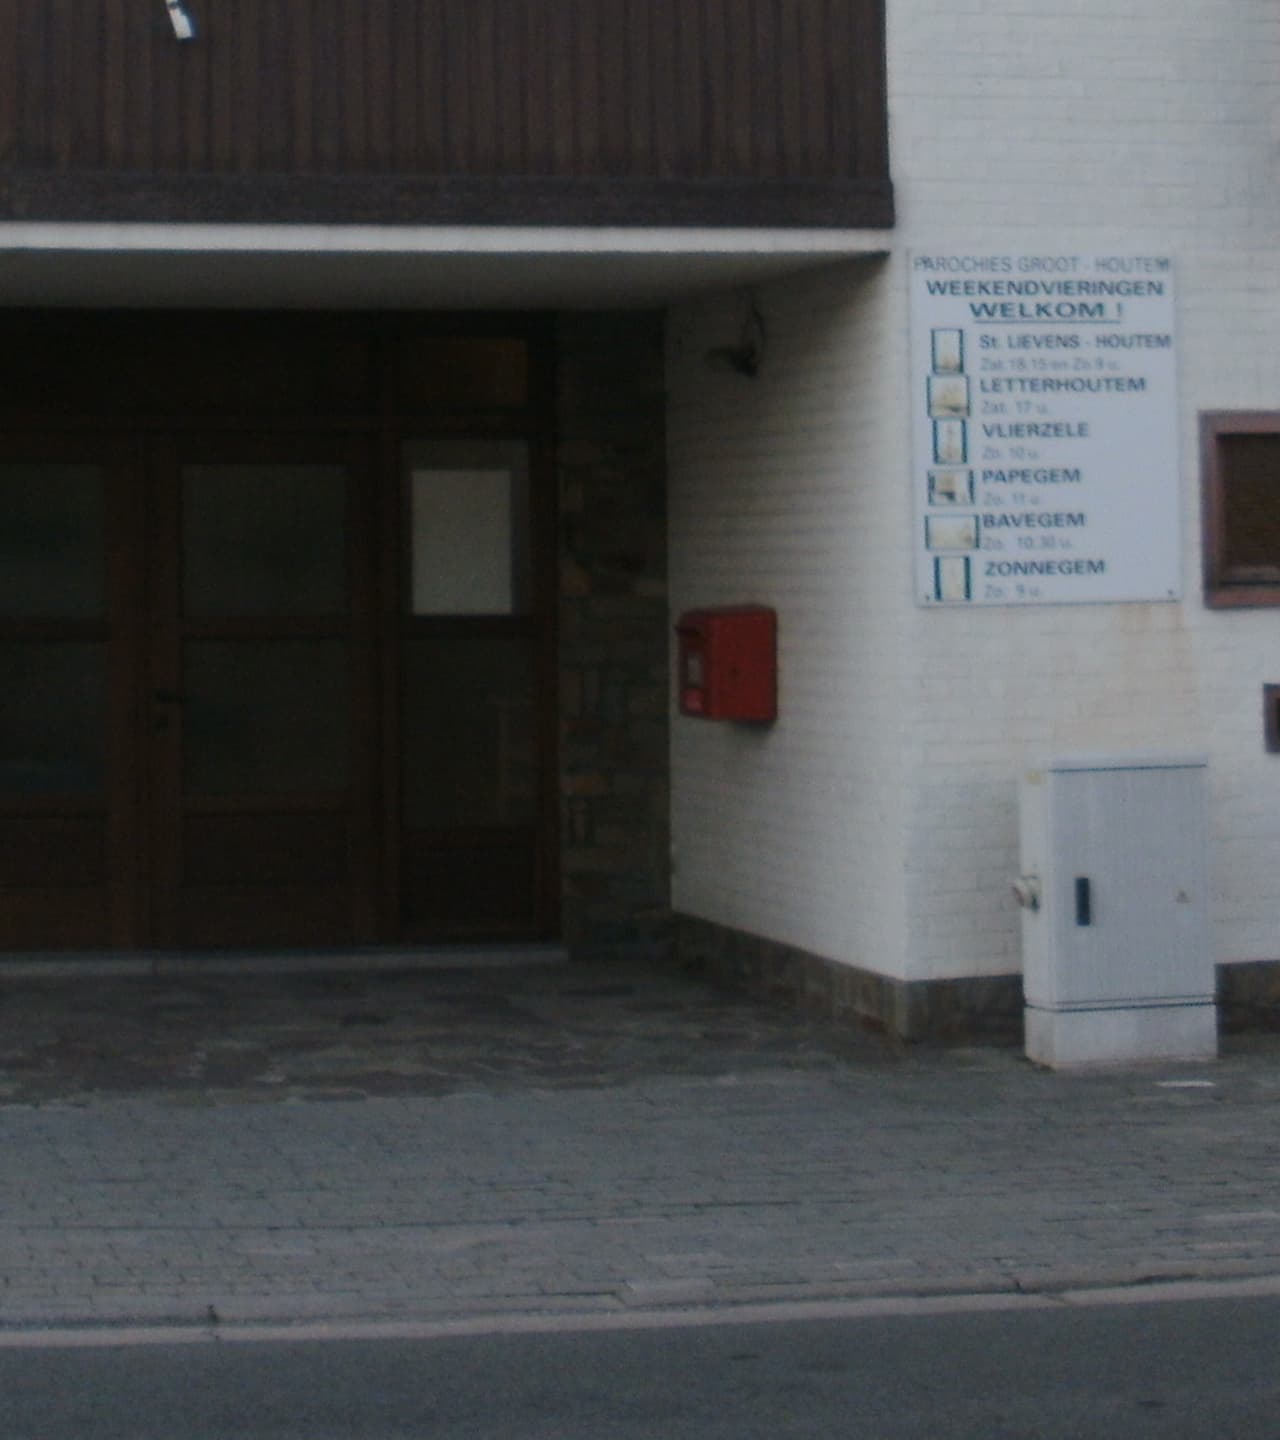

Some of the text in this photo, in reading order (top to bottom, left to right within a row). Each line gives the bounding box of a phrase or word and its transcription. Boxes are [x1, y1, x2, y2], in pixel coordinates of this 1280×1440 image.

[913, 257, 1012, 273] PAROCHIES
[1019, 257, 1077, 273] GROOT
[1095, 256, 1170, 273] HOUTEM
[926, 279, 1164, 297] WEEKENDVIERINGEN
[969, 301, 1105, 318] WELKOM
[1007, 334, 1080, 349] LIEVENS
[1095, 334, 1172, 348] HOUTEM
[979, 377, 1147, 393] LETTERHOUTEM
[982, 422, 1090, 438] VLIERZELE
[982, 468, 1081, 483] PAPEGEM
[982, 512, 1085, 528] BAVEGEM
[984, 559, 1106, 576] ZONNEGEM
